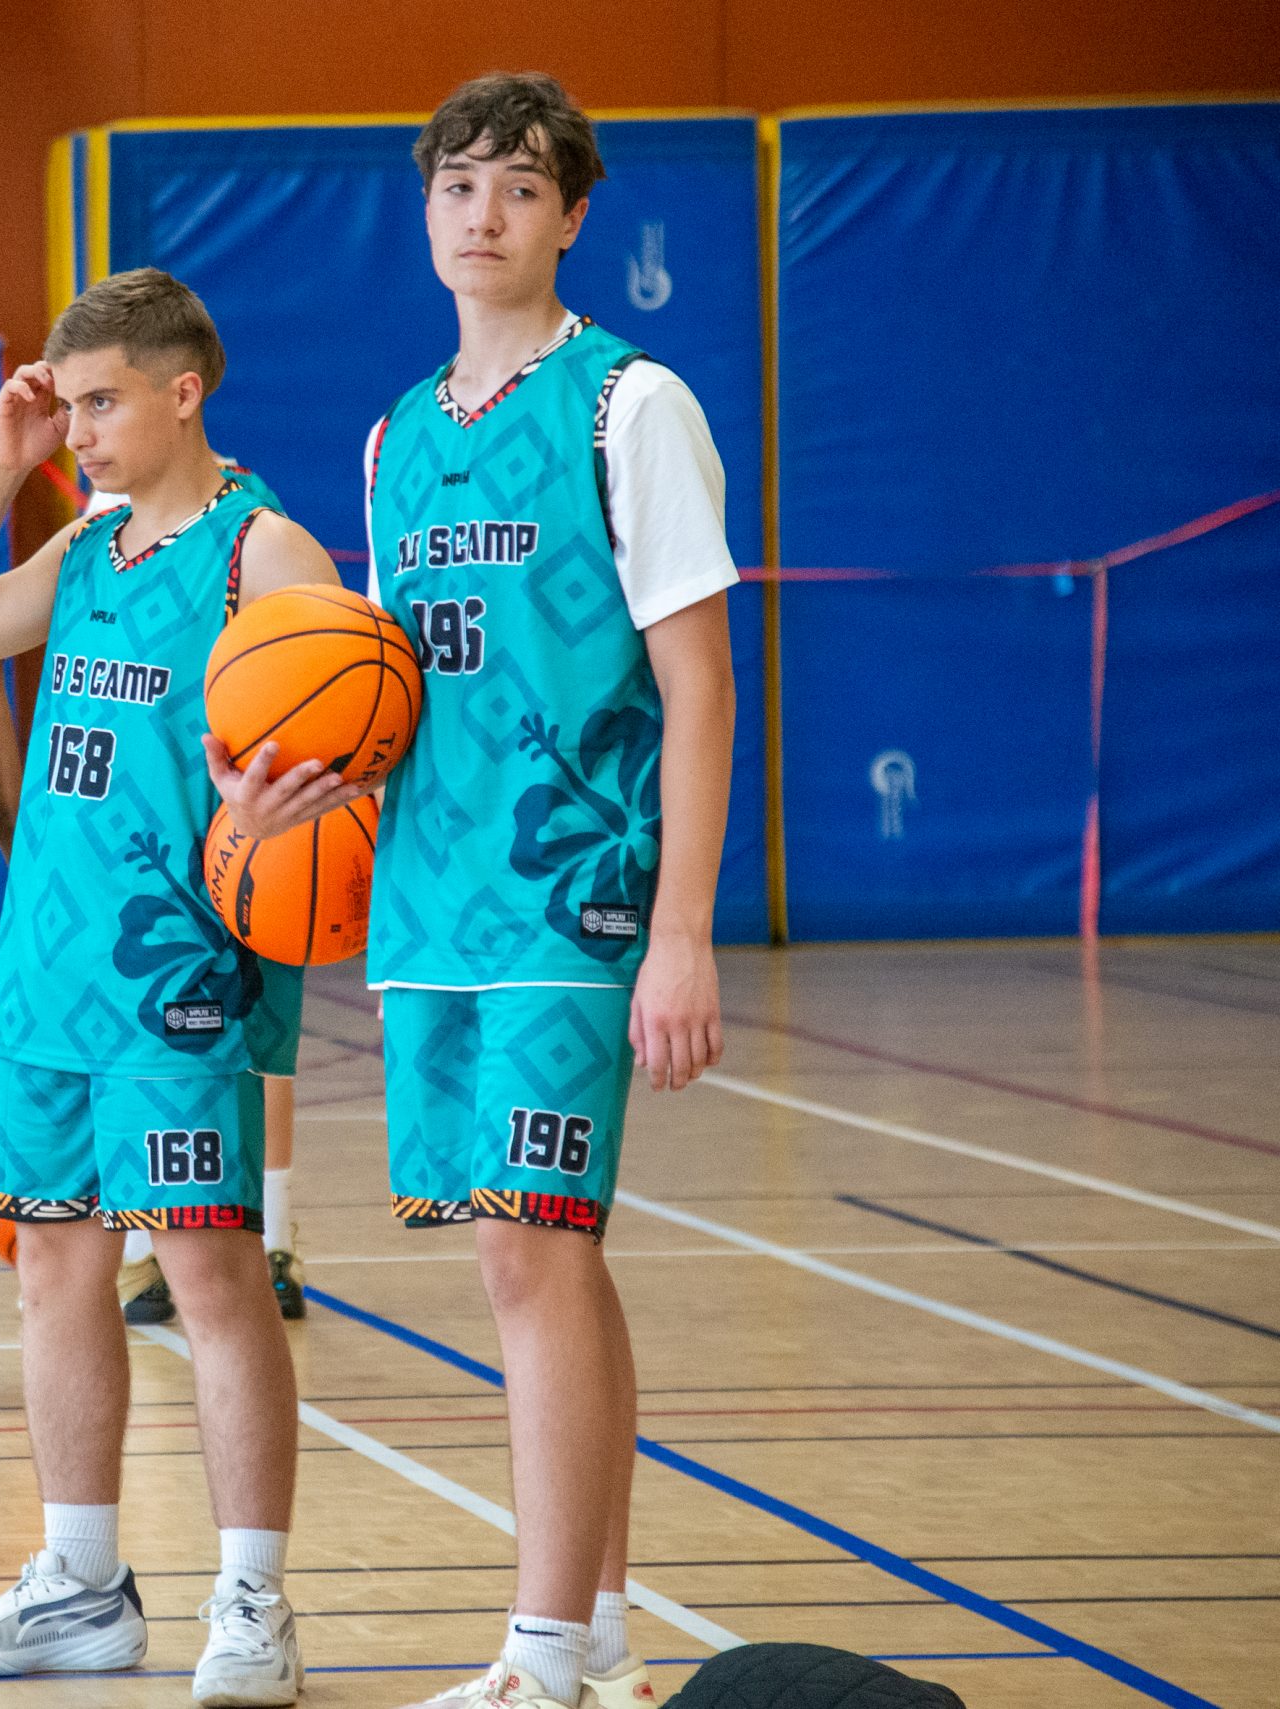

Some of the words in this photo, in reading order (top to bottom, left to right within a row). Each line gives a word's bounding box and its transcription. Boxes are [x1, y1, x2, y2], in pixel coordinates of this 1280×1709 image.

[68, 655, 88, 696] S
[88, 658, 172, 706] CAMP
[47, 723, 116, 801] 168
[144, 1129, 223, 1186] 168
[507, 1106, 594, 1177] 196
